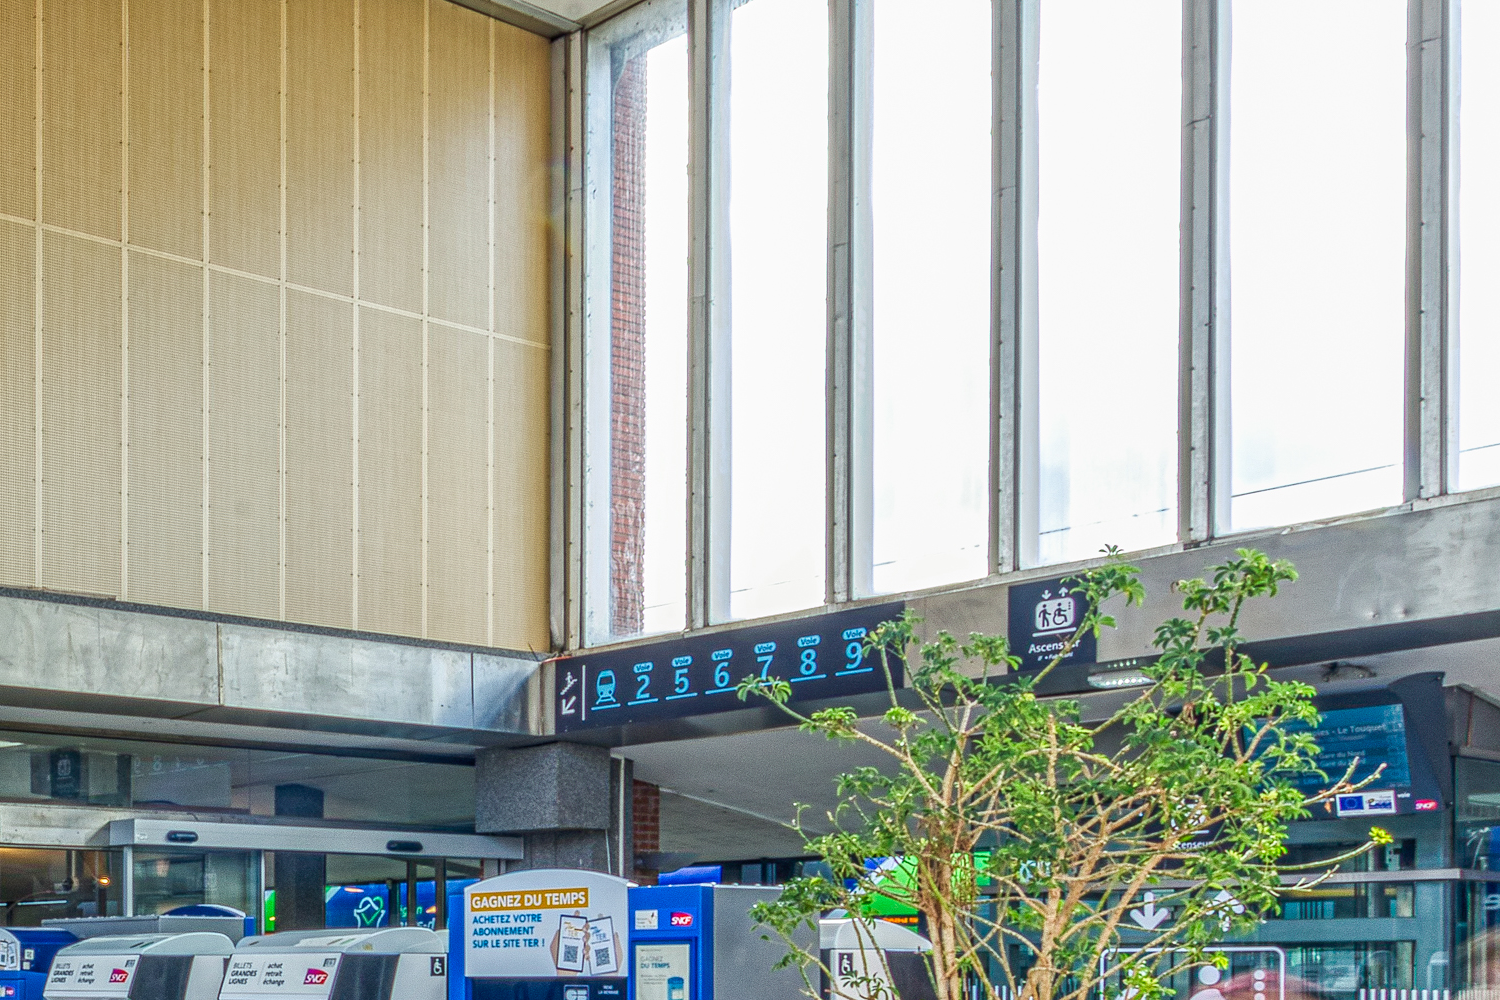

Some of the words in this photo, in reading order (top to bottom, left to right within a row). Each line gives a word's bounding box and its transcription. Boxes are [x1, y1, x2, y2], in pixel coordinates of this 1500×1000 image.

[636, 664, 651, 672] Voie
[674, 657, 690, 666] Voie
[714, 650, 730, 659] Voie
[757, 643, 773, 652] Voie
[800, 636, 817, 646] Voie
[846, 629, 863, 638] Voie
[1028, 640, 1080, 654] Ascensr
[636, 674, 650, 700] 2
[674, 668, 690, 694] 5
[714, 662, 730, 688] 6
[756, 654, 774, 680] 7
[800, 649, 817, 676] 8
[845, 641, 863, 669] 9
[472, 895, 522, 908] GAGNEZ
[524, 894, 542, 906] DU
[545, 892, 586, 906] TEMPS
[472, 915, 510, 924] ACHETEZ
[513, 914, 542, 922] VOTRE
[671, 916, 692, 925] SNCF
[472, 926, 534, 936] ABONNEMENT
[472, 940, 488, 948] SUR
[491, 939, 500, 948] LE
[503, 938, 521, 948] SITE
[524, 938, 538, 947] TER
[110, 974, 128, 982] SNCF
[305, 974, 326, 983] SNCF
